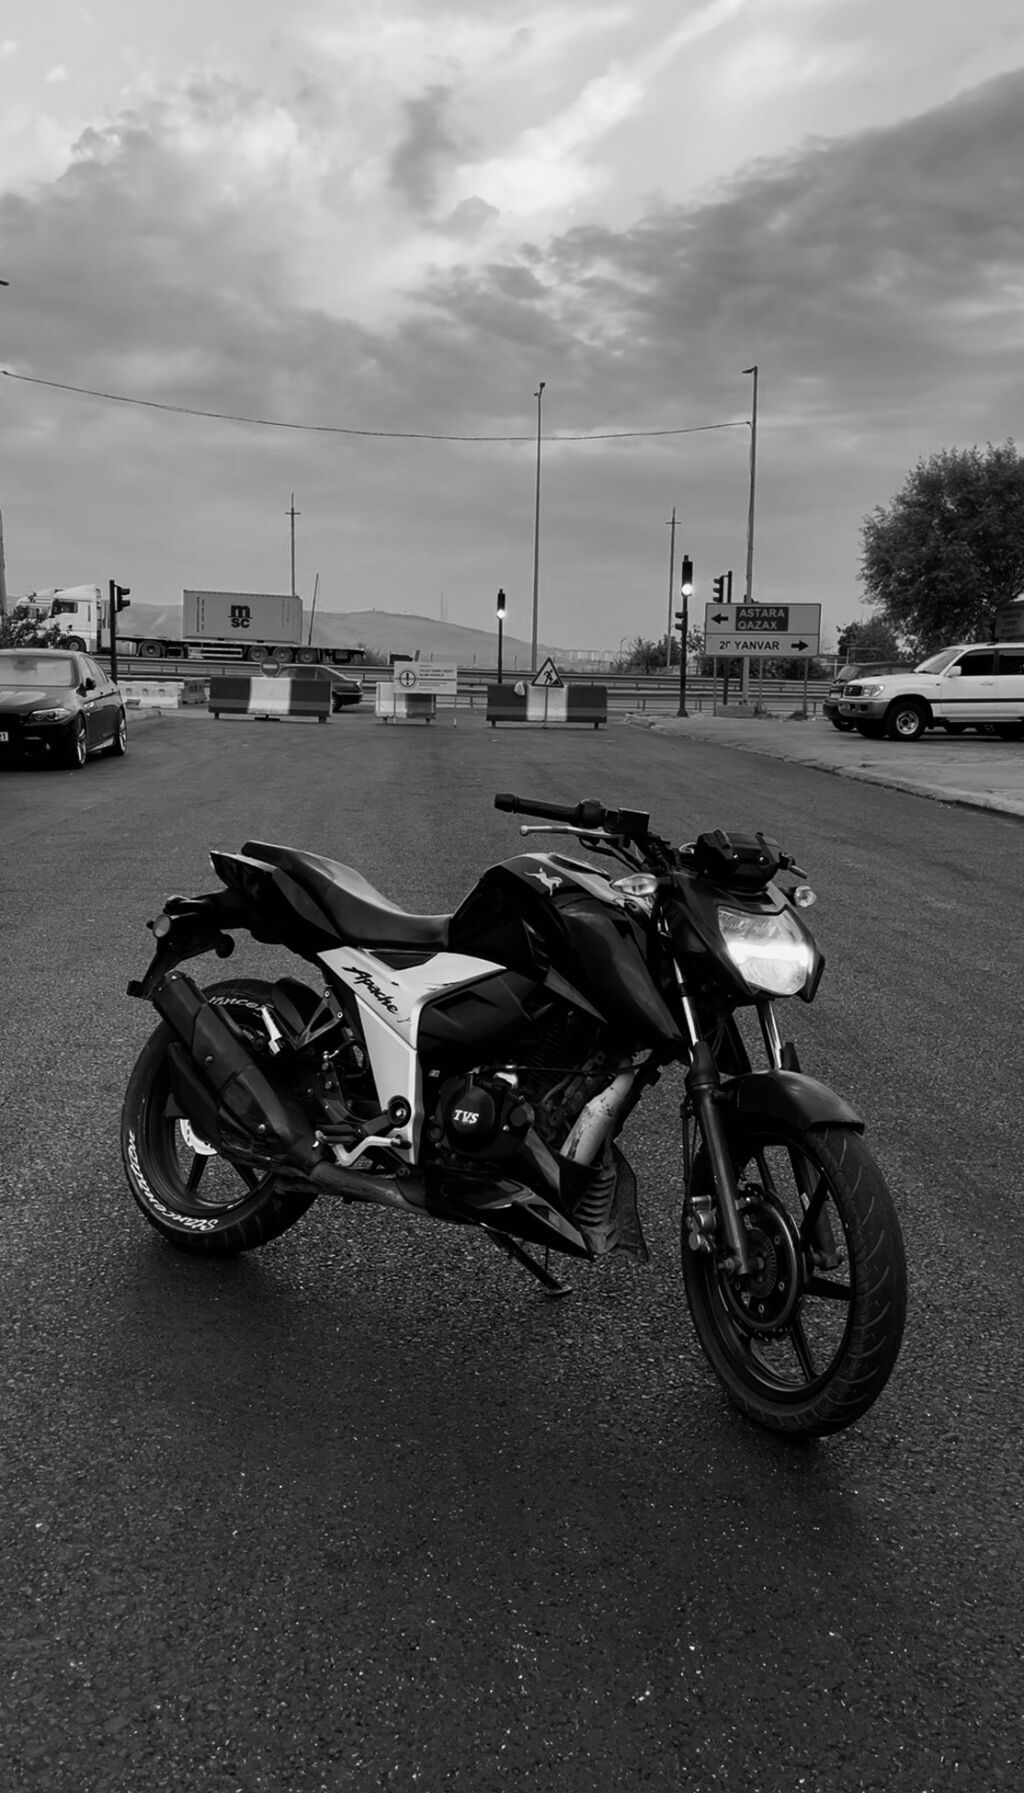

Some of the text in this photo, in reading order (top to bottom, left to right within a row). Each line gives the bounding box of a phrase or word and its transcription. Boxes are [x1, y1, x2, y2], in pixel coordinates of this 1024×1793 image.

[739, 608, 785, 618] ASTARA
[738, 621, 778, 630] QAZAX
[734, 641, 780, 650] YANVAR
[341, 966, 398, 1015] Apache
[454, 1109, 479, 1124] TVS
